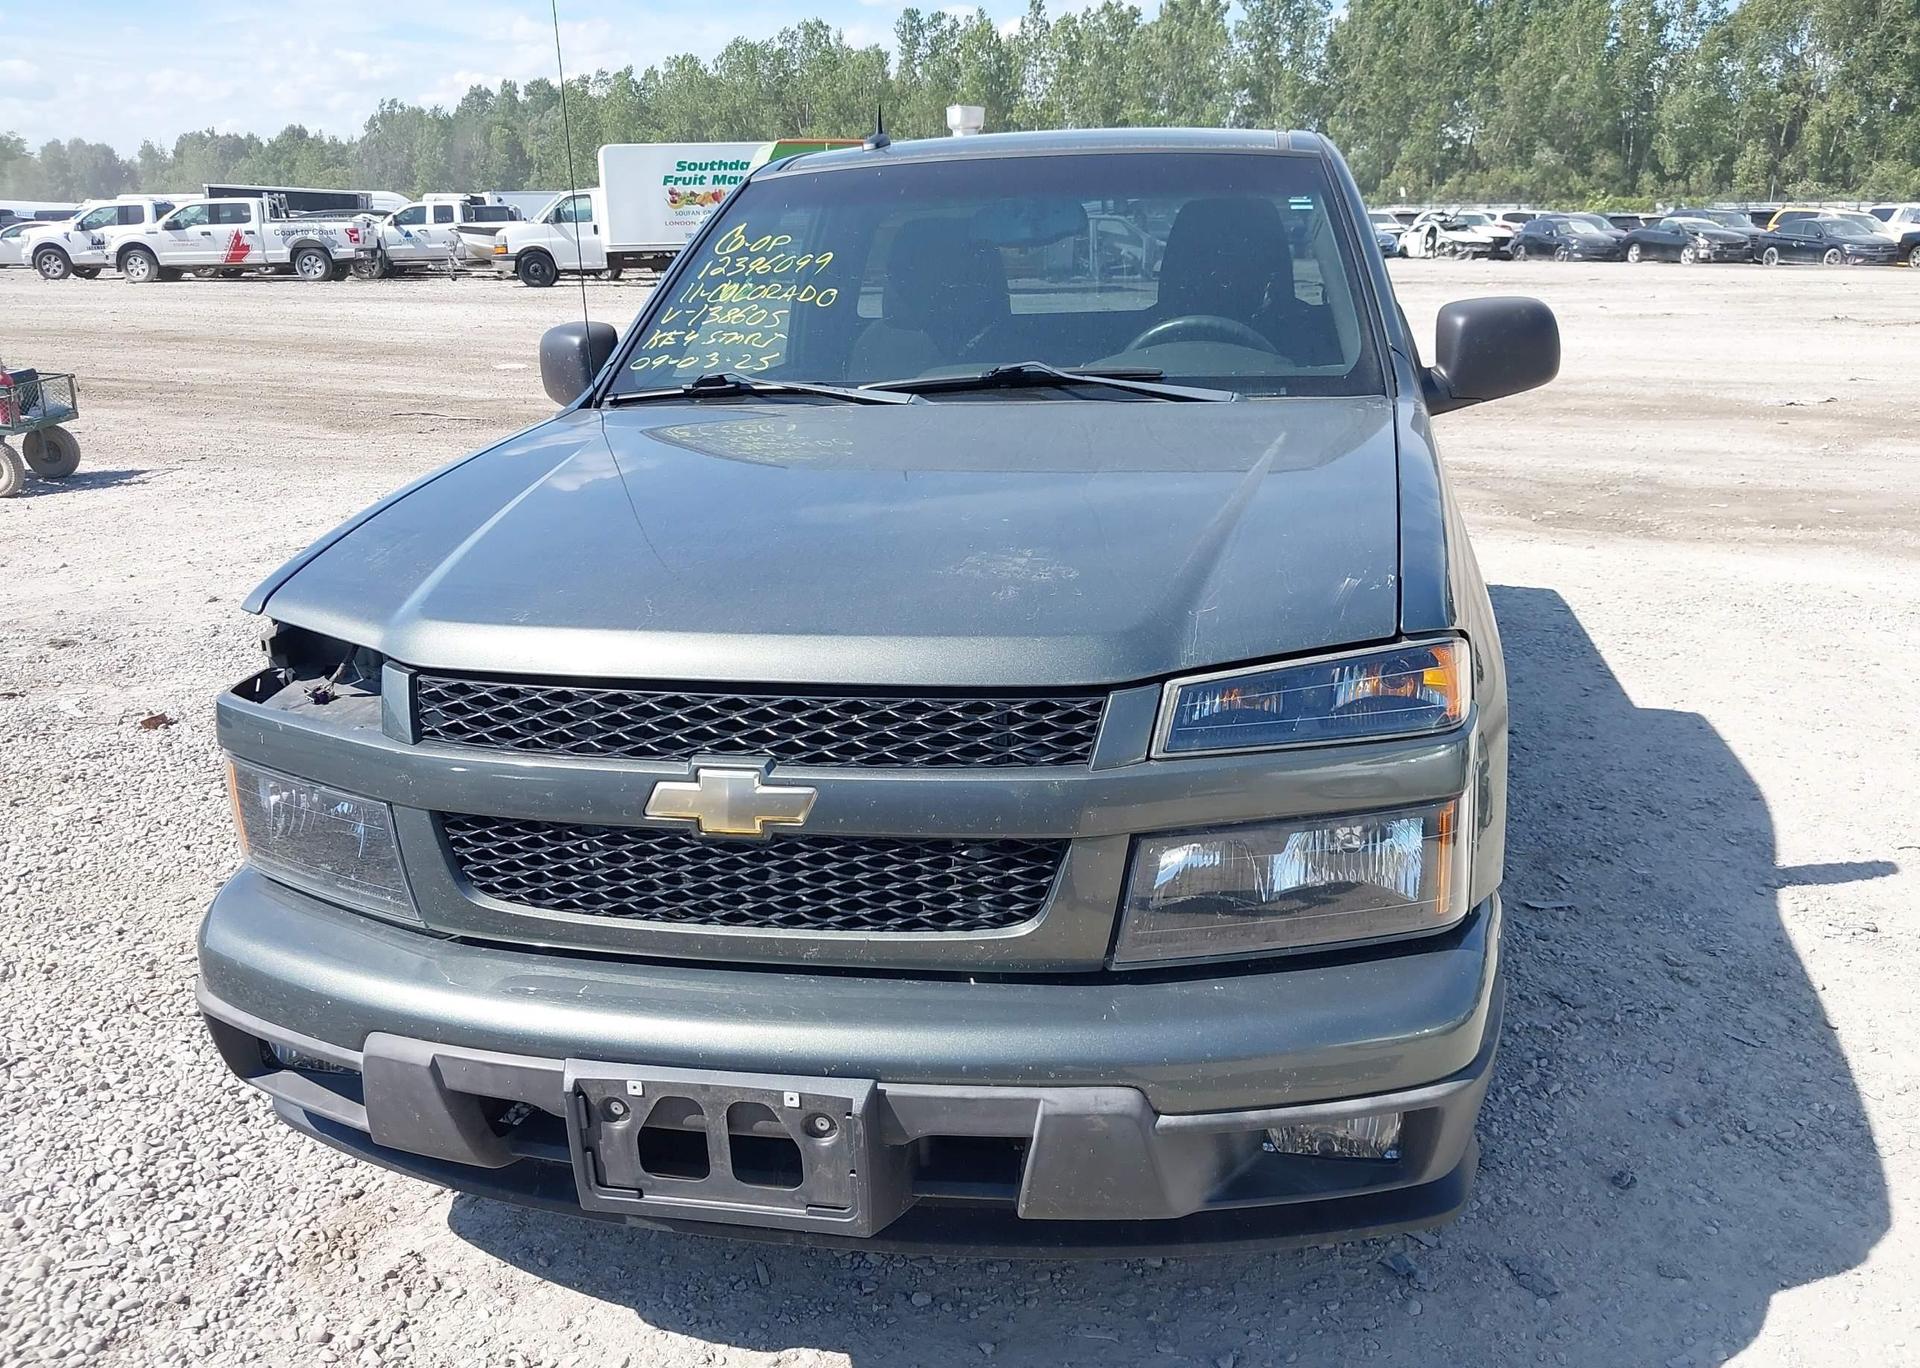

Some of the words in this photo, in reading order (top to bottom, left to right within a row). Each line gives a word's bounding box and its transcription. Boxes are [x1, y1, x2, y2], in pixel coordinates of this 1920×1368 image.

[663, 174, 707, 186] Fruit
[273, 228, 299, 237] Coast
[311, 228, 337, 236] Coast
